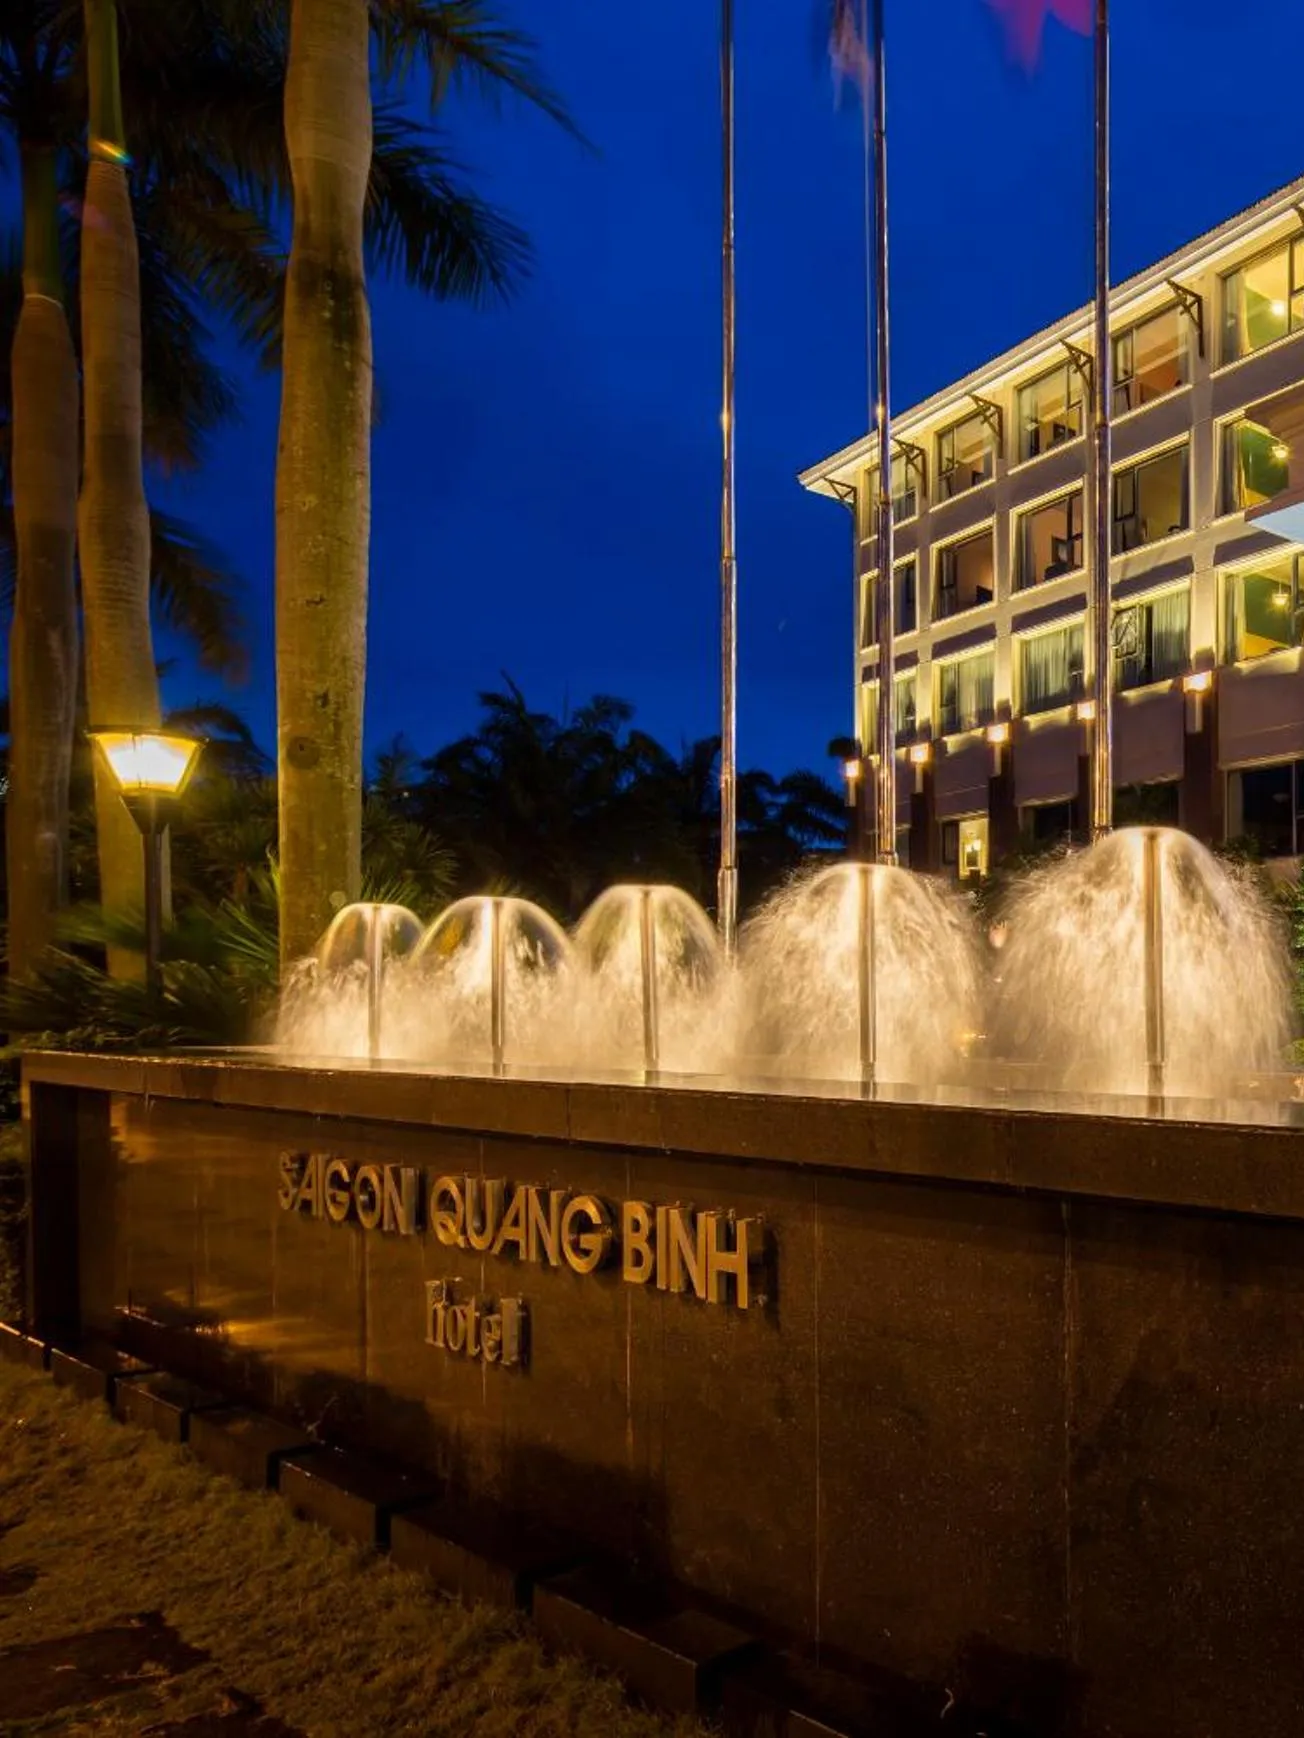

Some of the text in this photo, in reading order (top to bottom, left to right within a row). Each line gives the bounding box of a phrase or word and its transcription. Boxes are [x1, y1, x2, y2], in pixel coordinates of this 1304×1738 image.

[279, 1152, 752, 1309] SAIGON QUANG BINH
[424, 1278, 522, 1366] hotel
